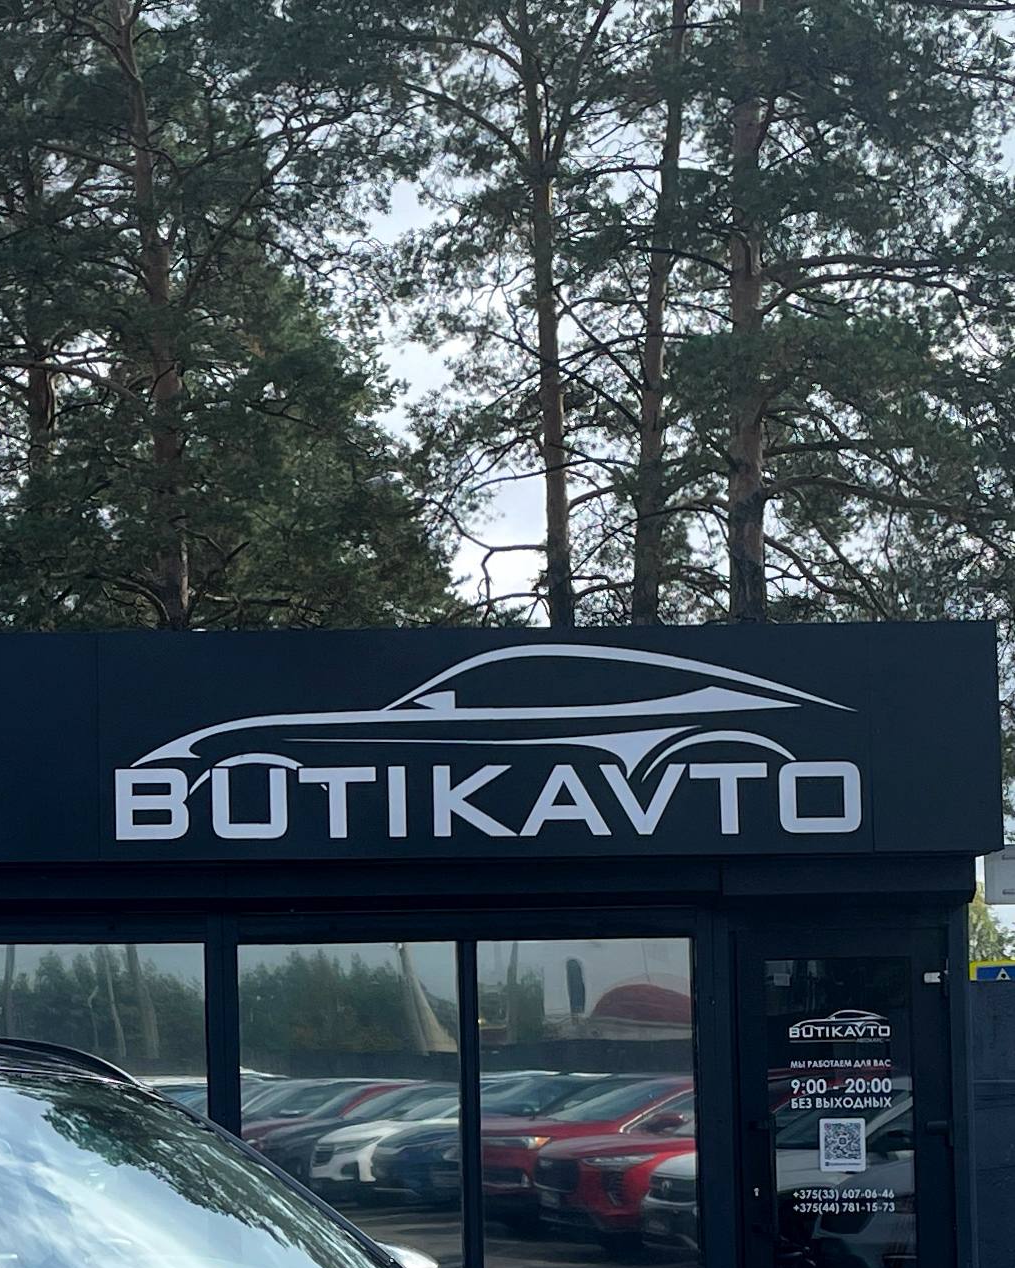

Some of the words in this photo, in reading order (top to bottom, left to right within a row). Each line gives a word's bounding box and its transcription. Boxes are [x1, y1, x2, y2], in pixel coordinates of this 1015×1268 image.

[115, 761, 862, 840] BUTIKAVTO
[789, 1025, 890, 1038] BUTIKAVTO
[790, 1060, 805, 1068] МЫ
[807, 1060, 852, 1068] РАБОТАЕМ
[853, 1059, 872, 1068] ДЛЯ
[873, 1059, 891, 1067] ВАС
[791, 1079, 827, 1094] 9:00
[844, 1078, 892, 1093] 20:00
[791, 1097, 812, 1109] БЕЗ
[815, 1096, 892, 1108] ВЫХОДНЫХ
